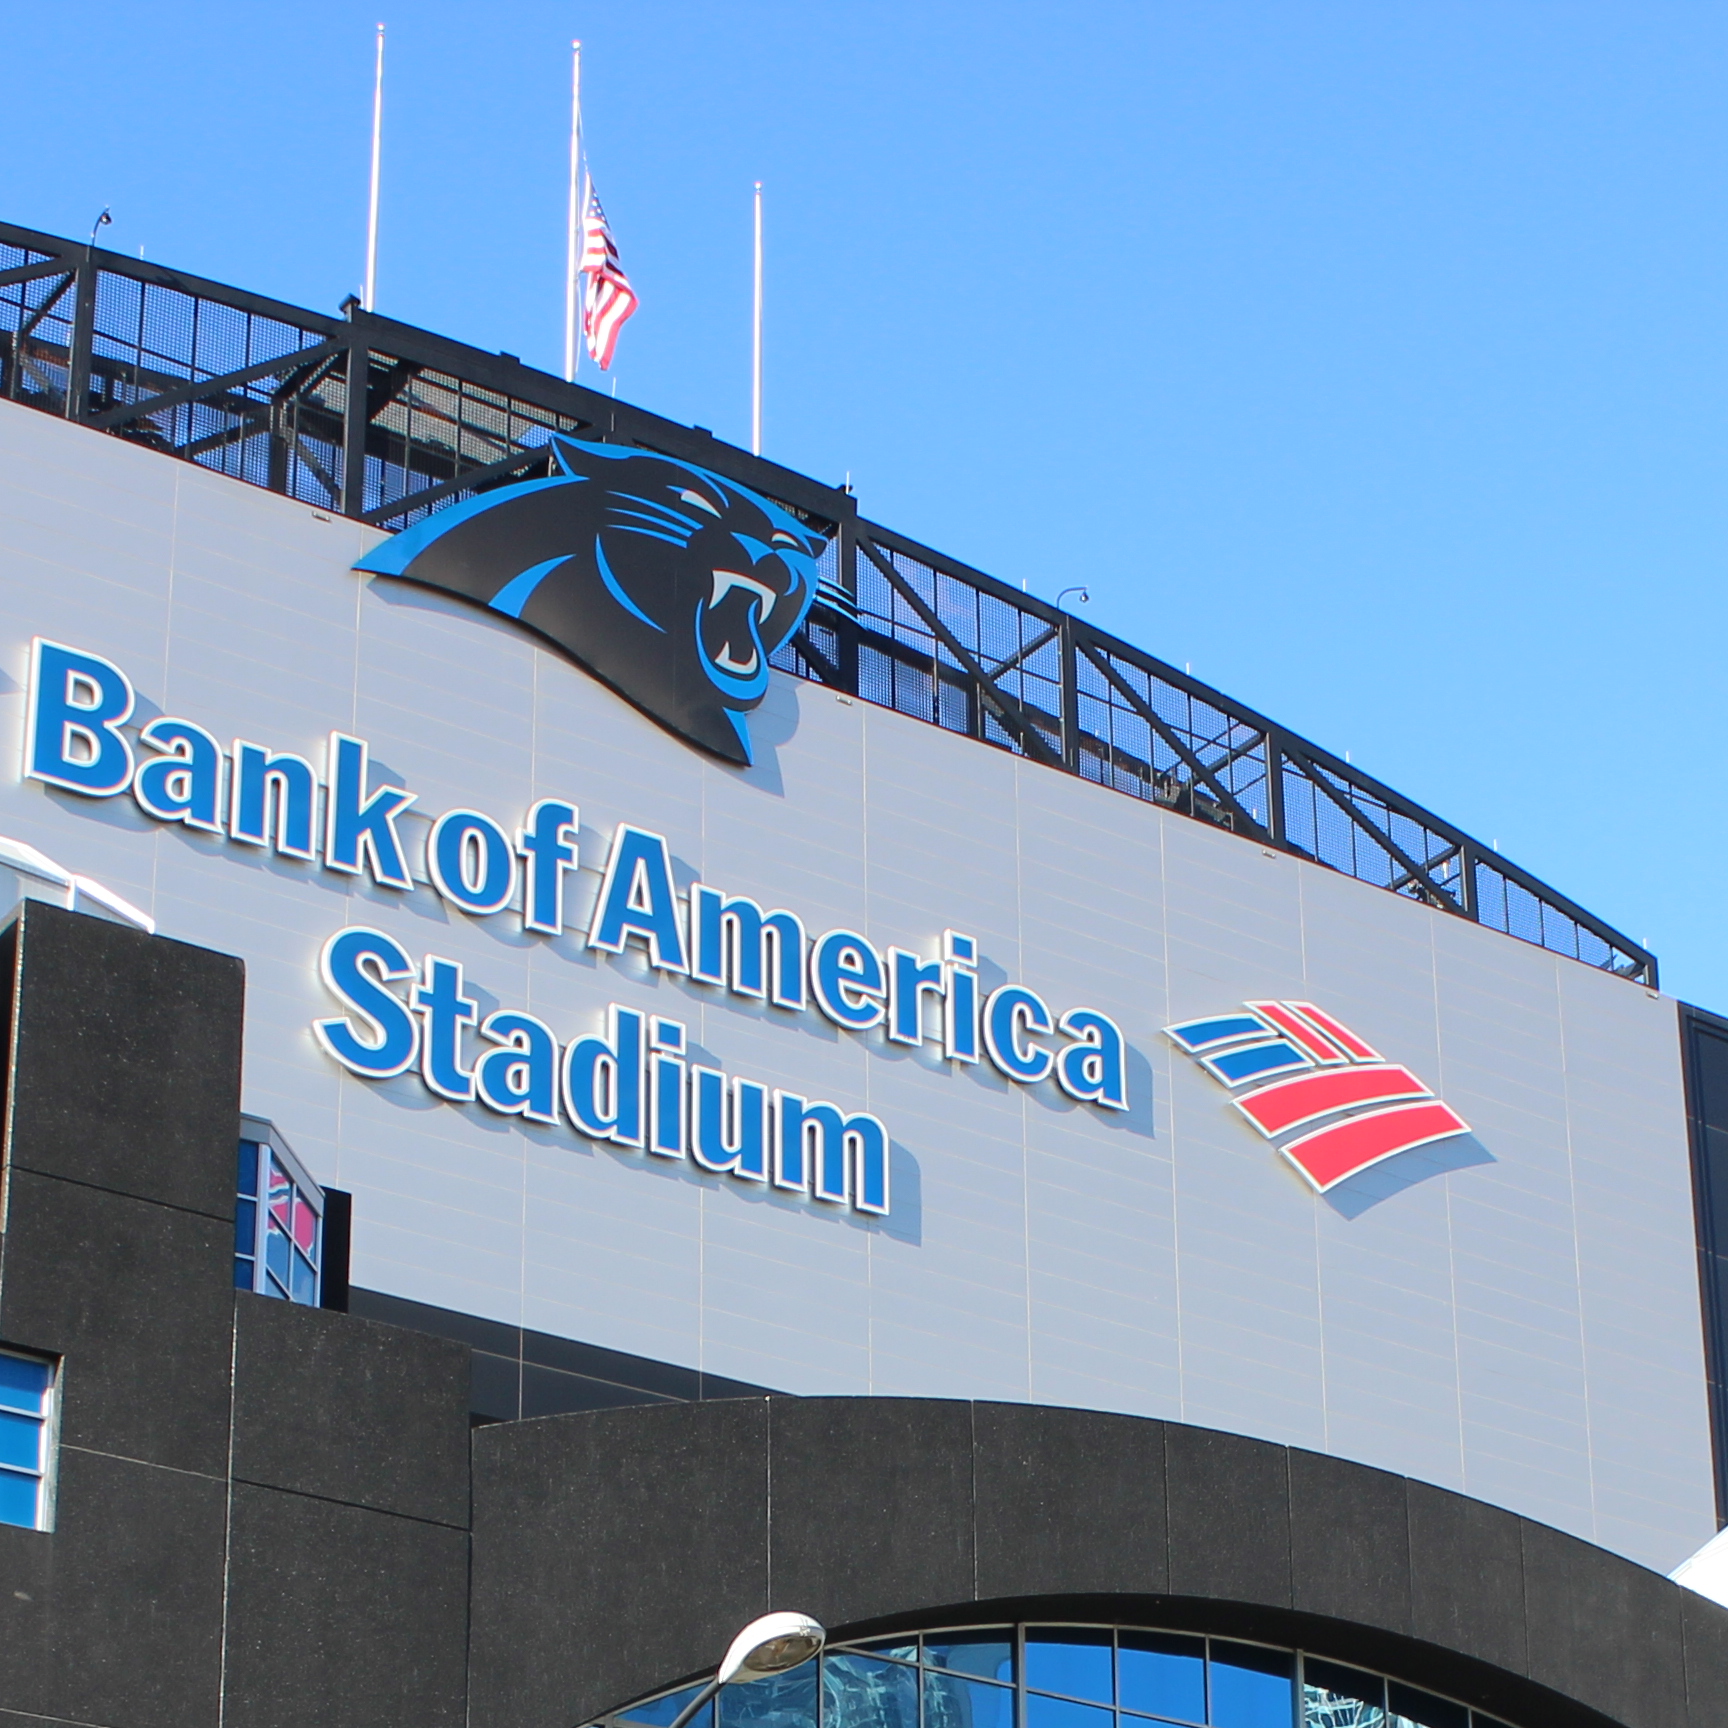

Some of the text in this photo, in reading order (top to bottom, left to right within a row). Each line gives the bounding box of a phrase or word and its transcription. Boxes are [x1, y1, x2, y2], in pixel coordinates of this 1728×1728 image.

[24, 637, 1129, 1112] Bank of America
[313, 926, 890, 1216] Stadium
